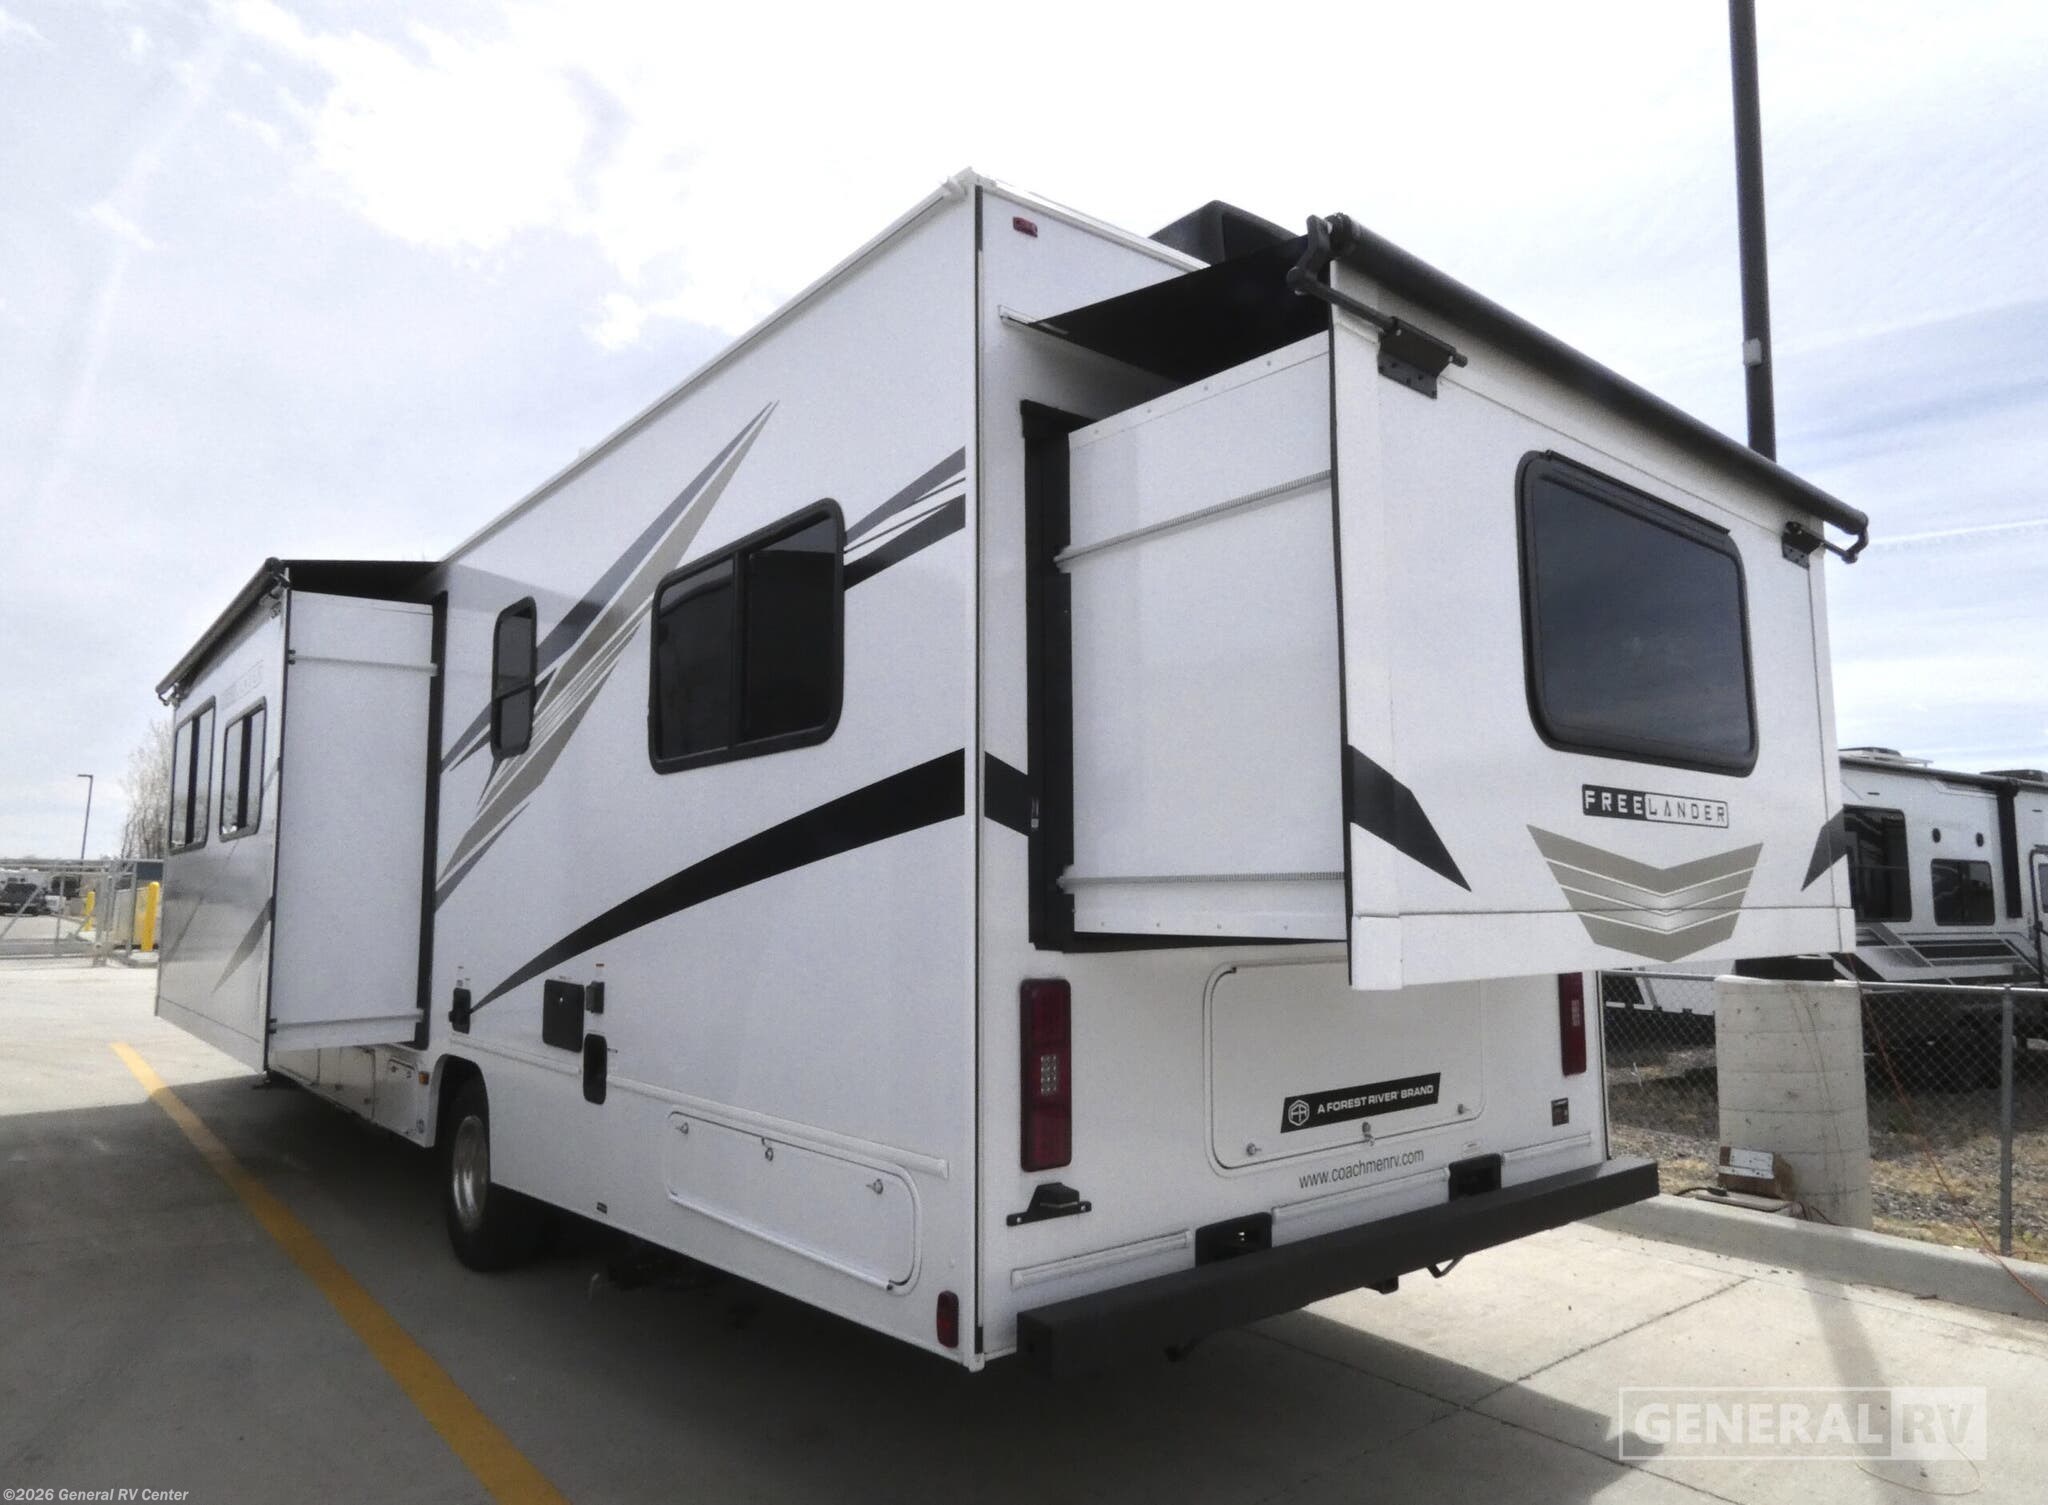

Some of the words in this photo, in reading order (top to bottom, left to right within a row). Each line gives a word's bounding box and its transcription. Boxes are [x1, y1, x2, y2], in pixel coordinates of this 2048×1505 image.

[1317, 1103, 1326, 1114] A
[1326, 1096, 1367, 1112] FOREST
[1368, 1091, 1398, 1105] RIVER
[1400, 1084, 1434, 1099] BRAND
[1299, 1150, 1425, 1189] www.coachmenrv.com
